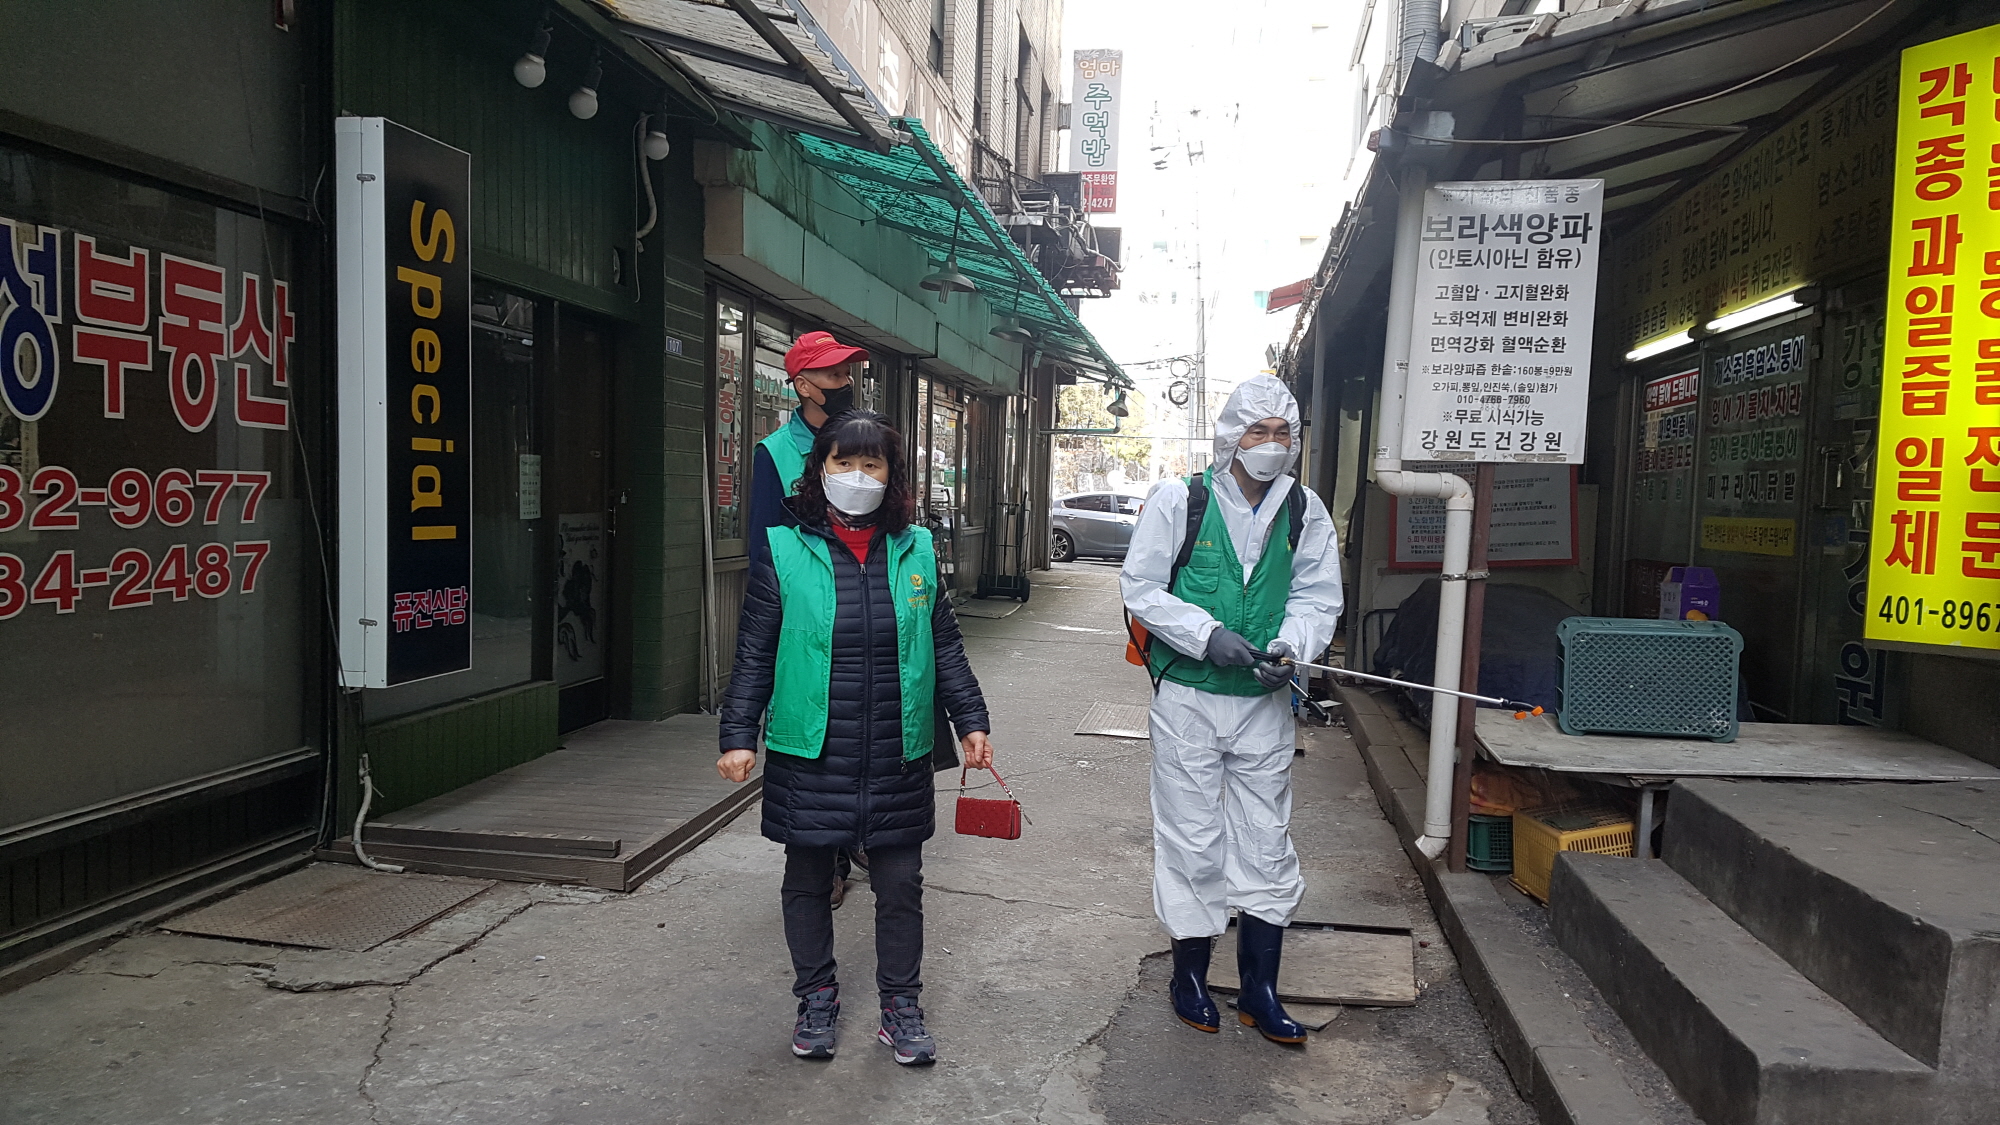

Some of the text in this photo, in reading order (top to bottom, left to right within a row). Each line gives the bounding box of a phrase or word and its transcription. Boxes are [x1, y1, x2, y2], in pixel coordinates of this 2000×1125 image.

[1080, 59, 1120, 79] 엄마
[1082, 83, 1112, 167] 주먹밥
[1915, 63, 1973, 201] 각종
[1525, 184, 1580, 203] 신품종
[1422, 211, 1593, 245] 보라색양파
[1429, 247, 1582, 271] (안토시아닌 함유)
[1434, 284, 1569, 303] 고혈압 고지혈완화
[1431, 310, 1569, 328] 노화억제 변비완화
[1430, 336, 1567, 354] 면역강화 혈액순환
[397, 199, 457, 541] Special
[1487, 410, 1545, 427] 시식가능
[1884, 437, 1946, 575] 일체
[392, 586, 468, 632] 퓨전식당
